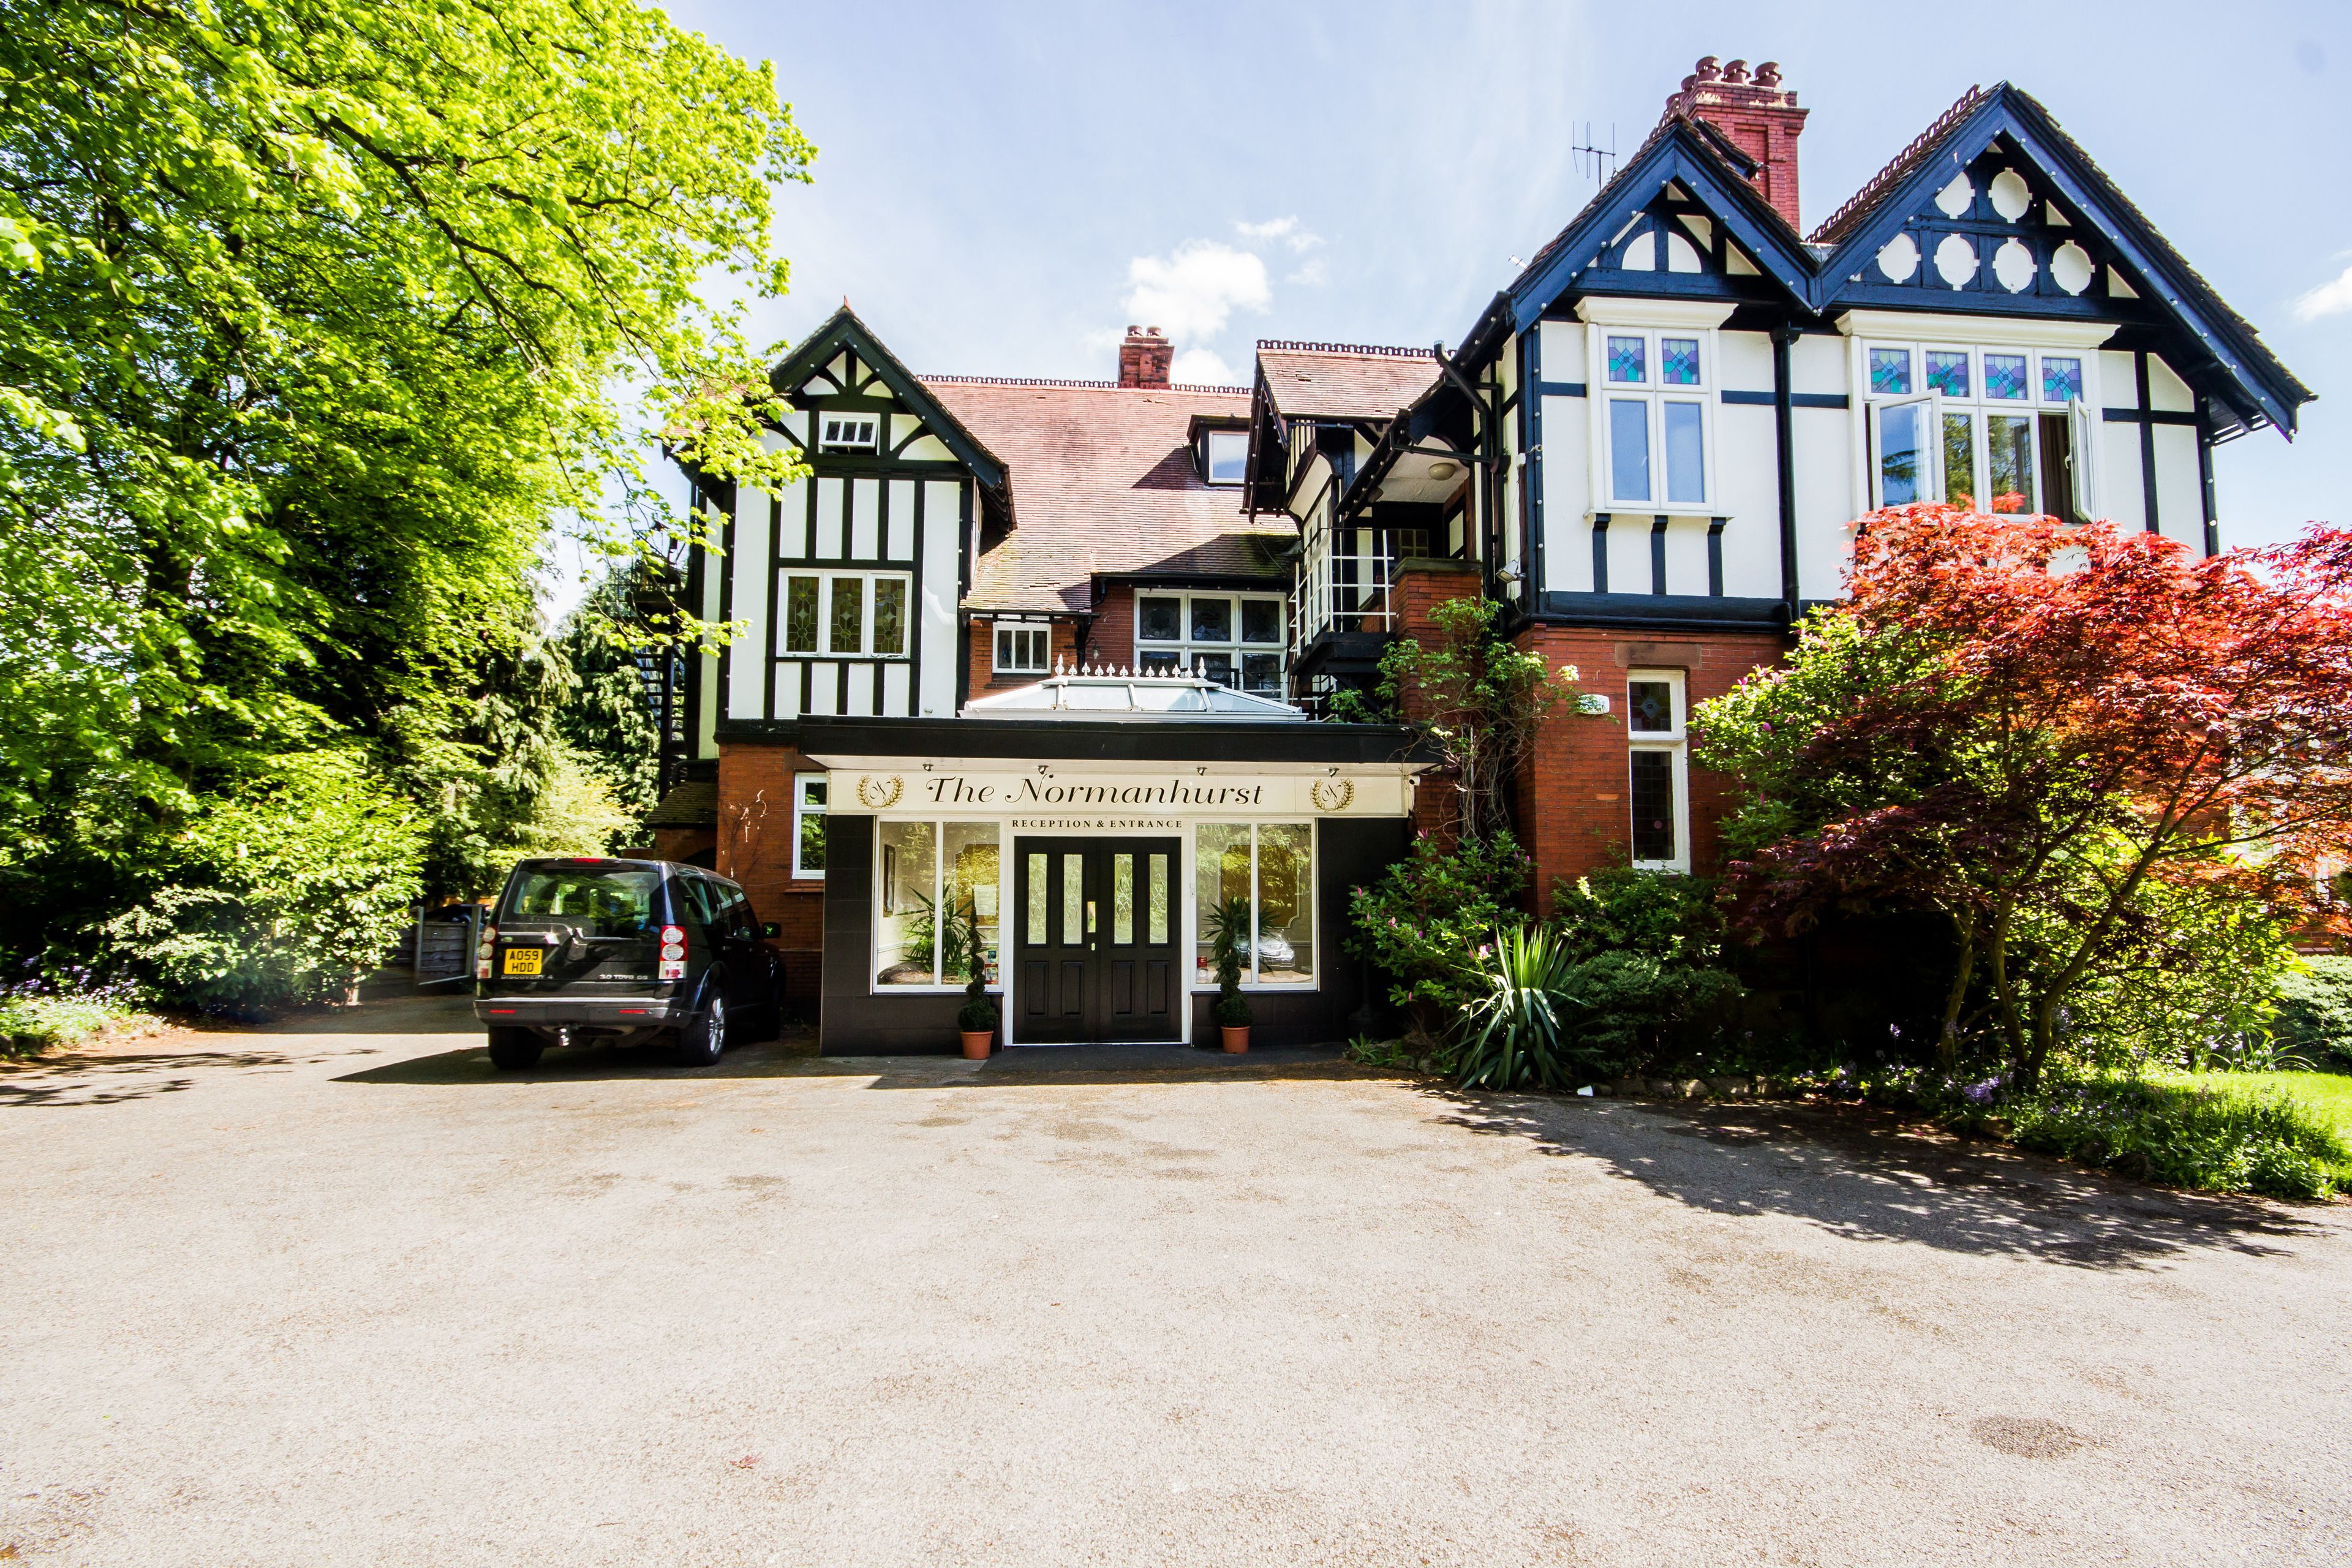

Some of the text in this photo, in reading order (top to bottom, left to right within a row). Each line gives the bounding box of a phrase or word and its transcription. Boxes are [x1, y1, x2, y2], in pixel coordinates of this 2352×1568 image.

[925, 774, 1264, 804] The Normanhurst
[1012, 820, 1182, 828] RECEPTION & ENTRANCE
[509, 950, 538, 961] AO59
[511, 962, 534, 973] HDD
